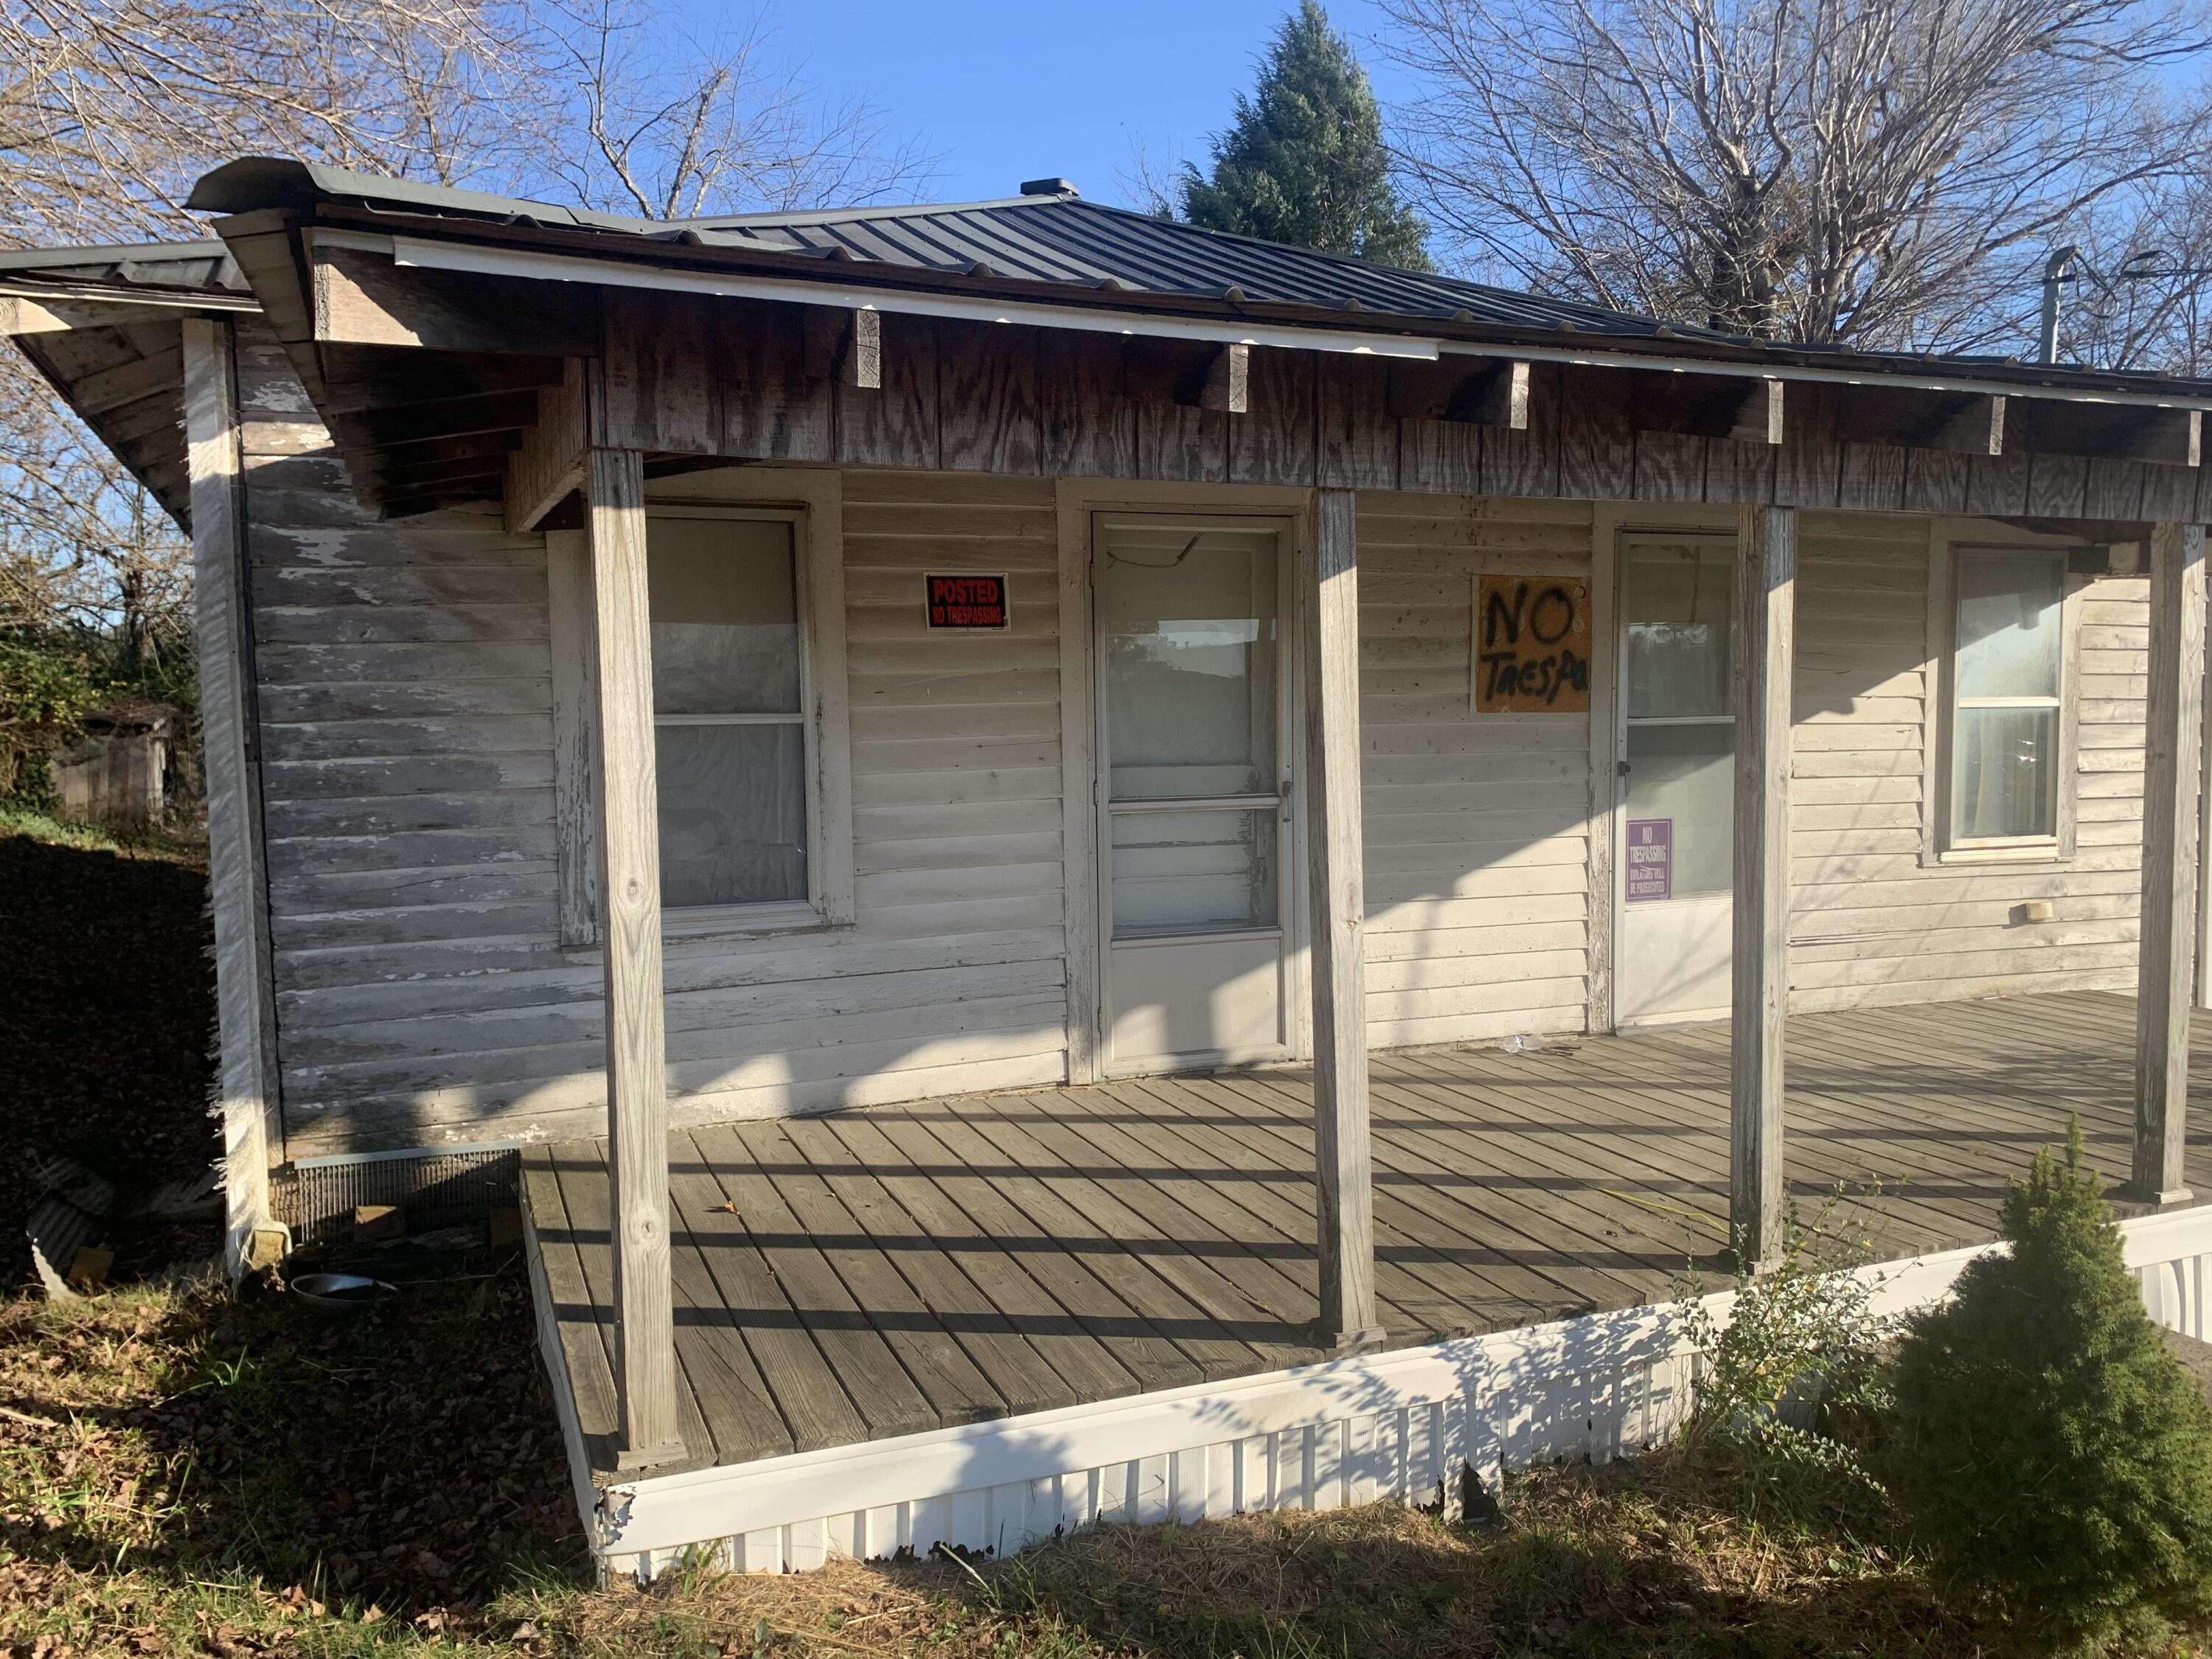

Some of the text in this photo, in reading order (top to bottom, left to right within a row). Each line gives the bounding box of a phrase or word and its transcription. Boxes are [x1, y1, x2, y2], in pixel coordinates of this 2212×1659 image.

[933, 580, 998, 603] POSTED
[933, 606, 1001, 625] NO TRESPASSING
[1484, 582, 1574, 647] NO
[1642, 827, 1652, 844] NO
[1630, 844, 1666, 863] TRESPASSING
[1630, 867, 1665, 894] BE PROSECUTED WILL
